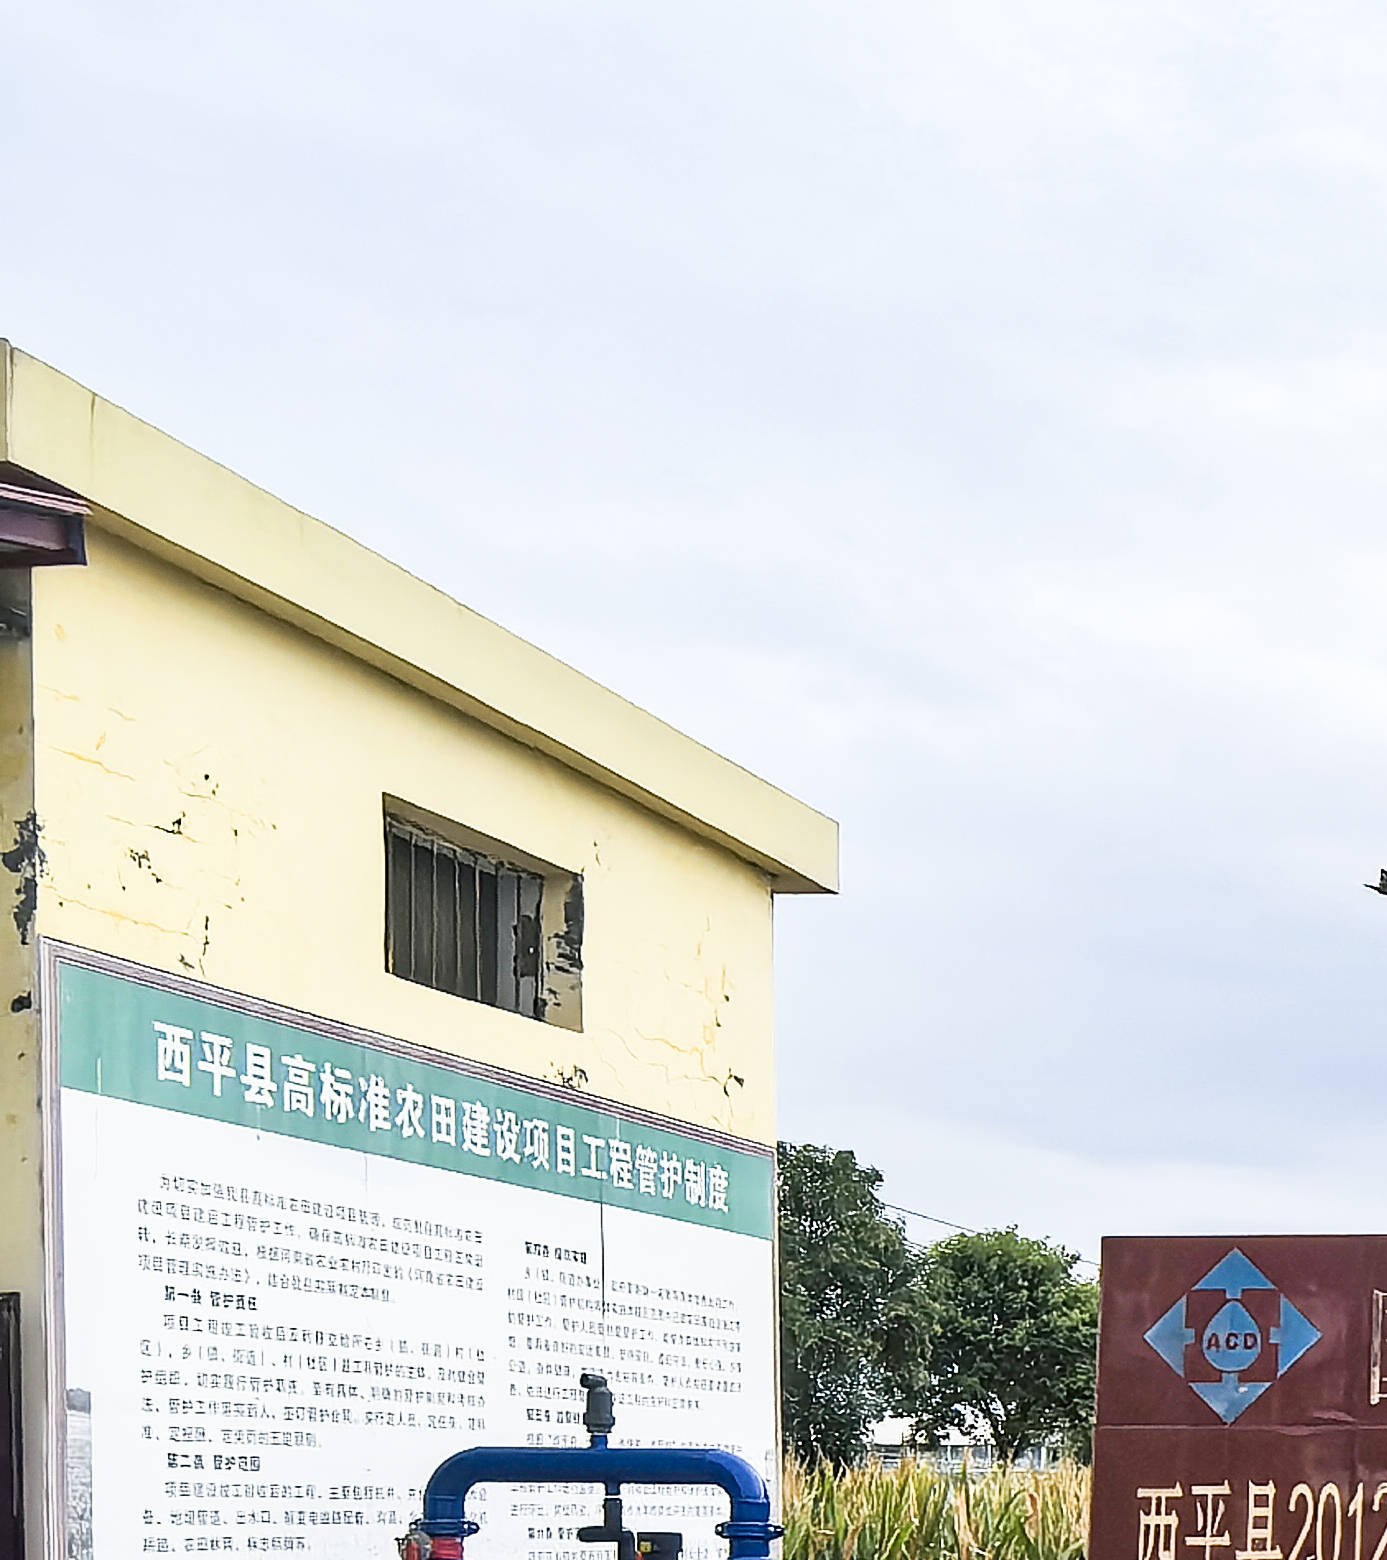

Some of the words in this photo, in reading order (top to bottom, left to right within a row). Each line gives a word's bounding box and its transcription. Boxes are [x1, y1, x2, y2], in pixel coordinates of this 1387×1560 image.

[153, 1020, 731, 1213] 西平县高标准农田建设项目工程管护制度
[1206, 1330, 1258, 1352] ACD
